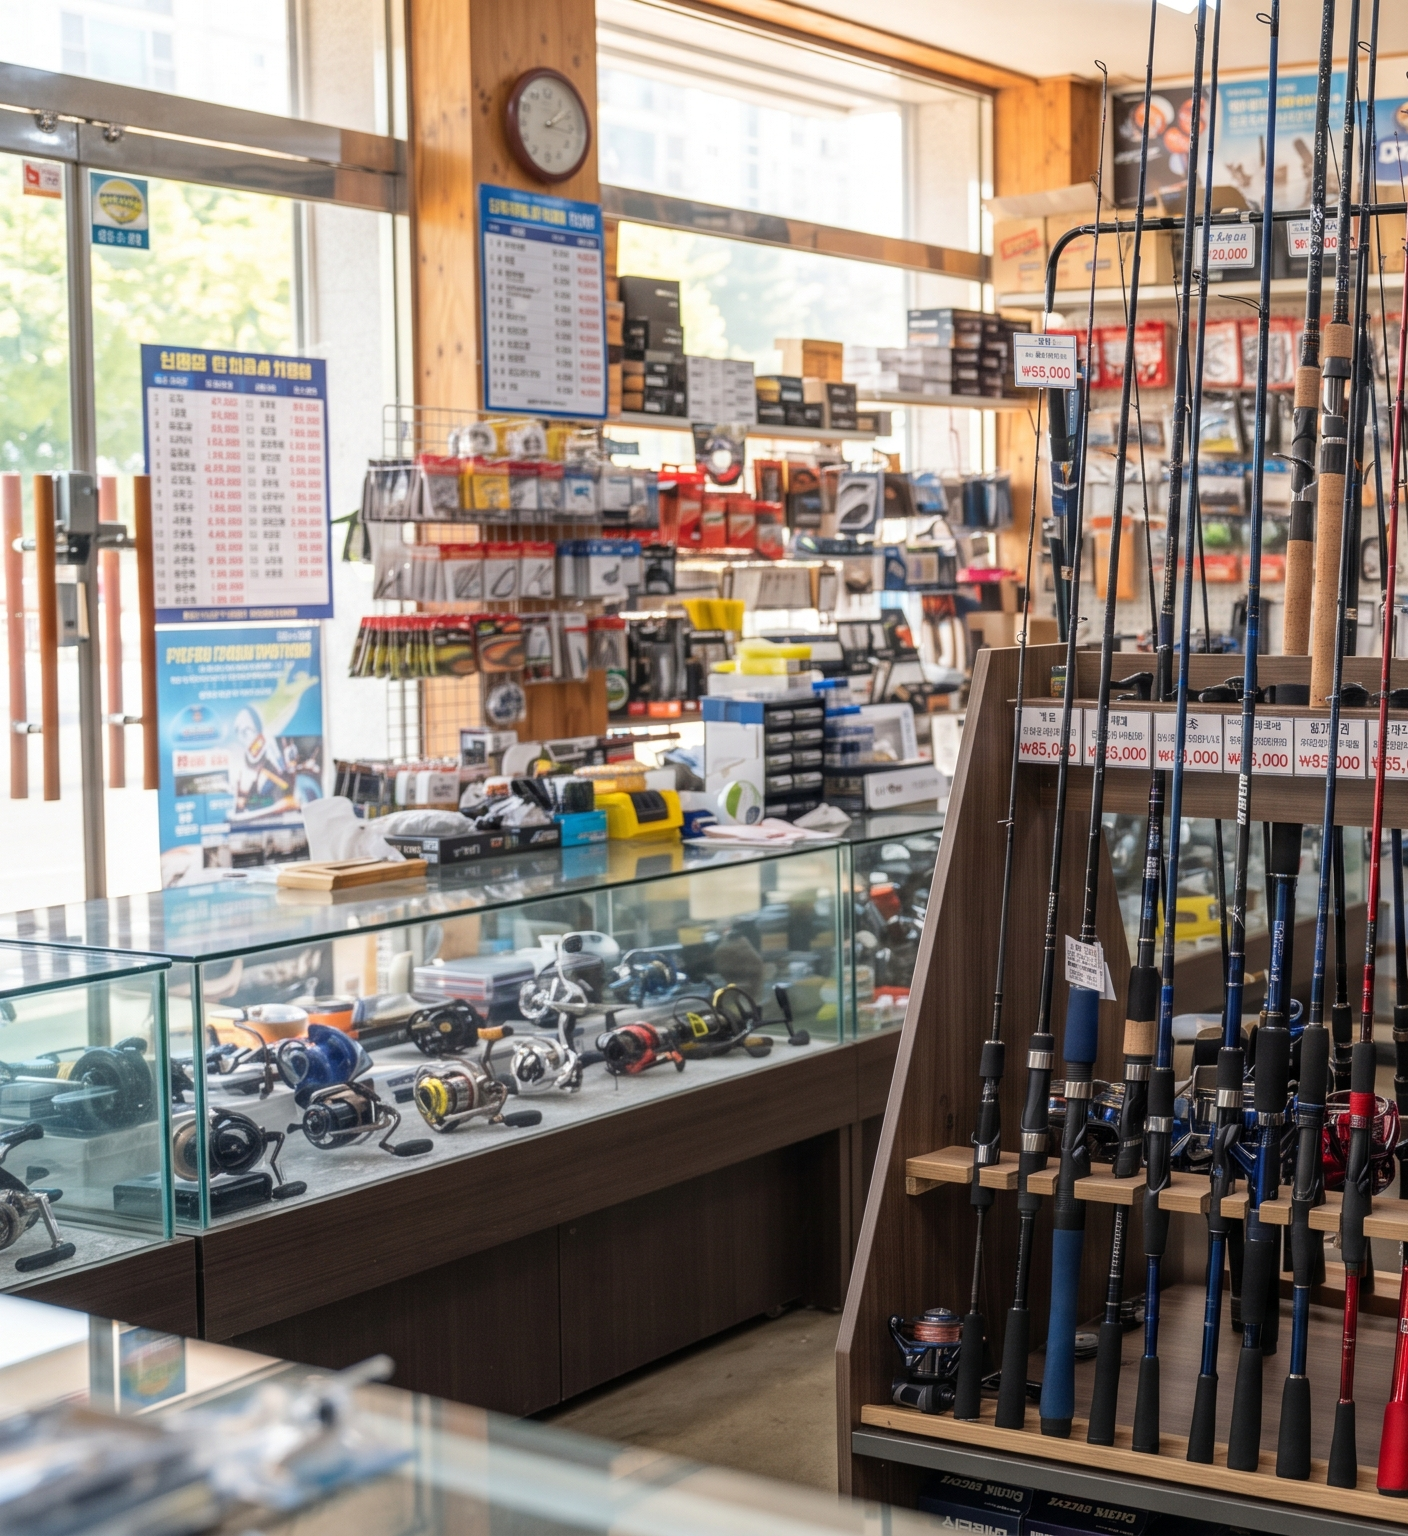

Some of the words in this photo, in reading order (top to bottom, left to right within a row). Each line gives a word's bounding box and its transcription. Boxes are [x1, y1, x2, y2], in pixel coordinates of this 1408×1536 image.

[1208, 247, 1248, 261] 20,000
[1020, 742, 1077, 758] ₩85,00
[1299, 754, 1360, 770] ₩85000
